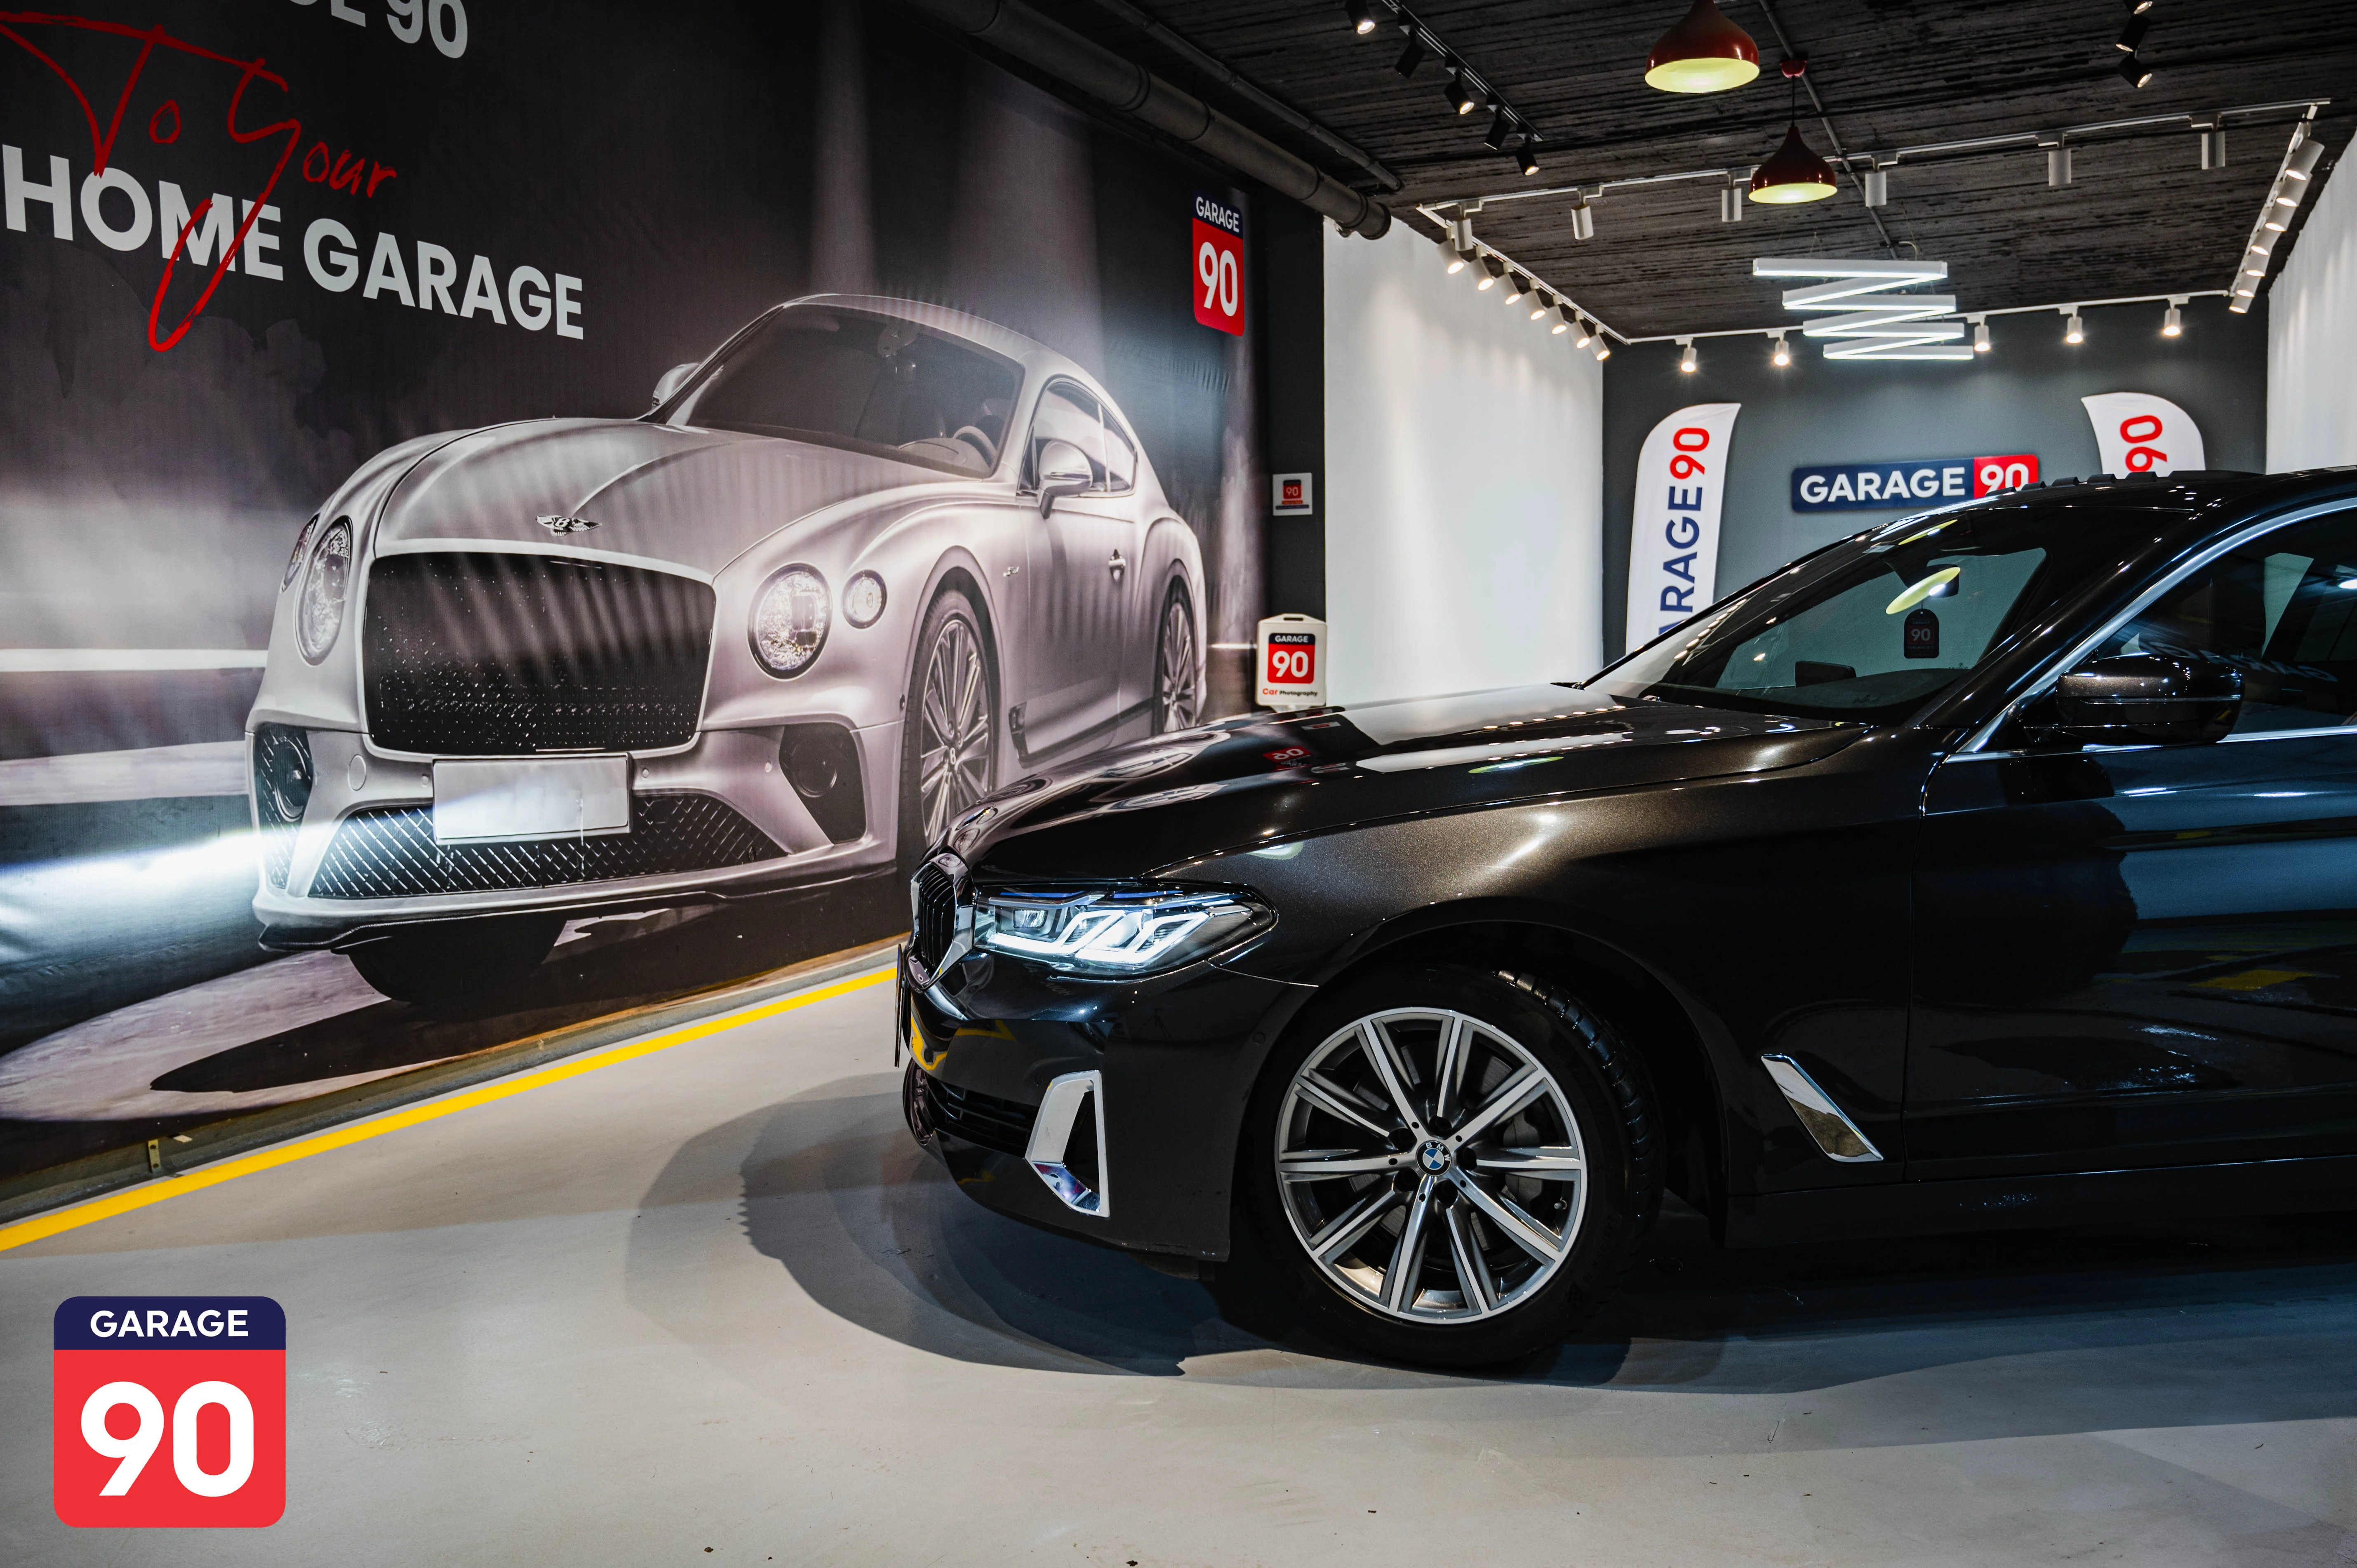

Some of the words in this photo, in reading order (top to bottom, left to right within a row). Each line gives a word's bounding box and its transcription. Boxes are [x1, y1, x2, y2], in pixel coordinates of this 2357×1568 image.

[387, 0, 468, 58] 90
[0, 11, 181, 178] To
[148, 58, 397, 352] Your
[1196, 196, 1240, 233] GARAGE
[2, 144, 284, 281] HOME
[303, 218, 584, 340] GARAGE
[1199, 242, 1238, 317] 90
[1669, 427, 1710, 480] 90
[2119, 415, 2168, 472] 90
[1286, 487, 1299, 496] 90
[1800, 467, 1965, 504] GARAGE
[1980, 463, 2030, 496] 90
[1658, 486, 1703, 635] RAGE
[1911, 628, 1931, 641] 90
[1272, 650, 1309, 678] 90
[1425, 1142, 1451, 1161] BMW
